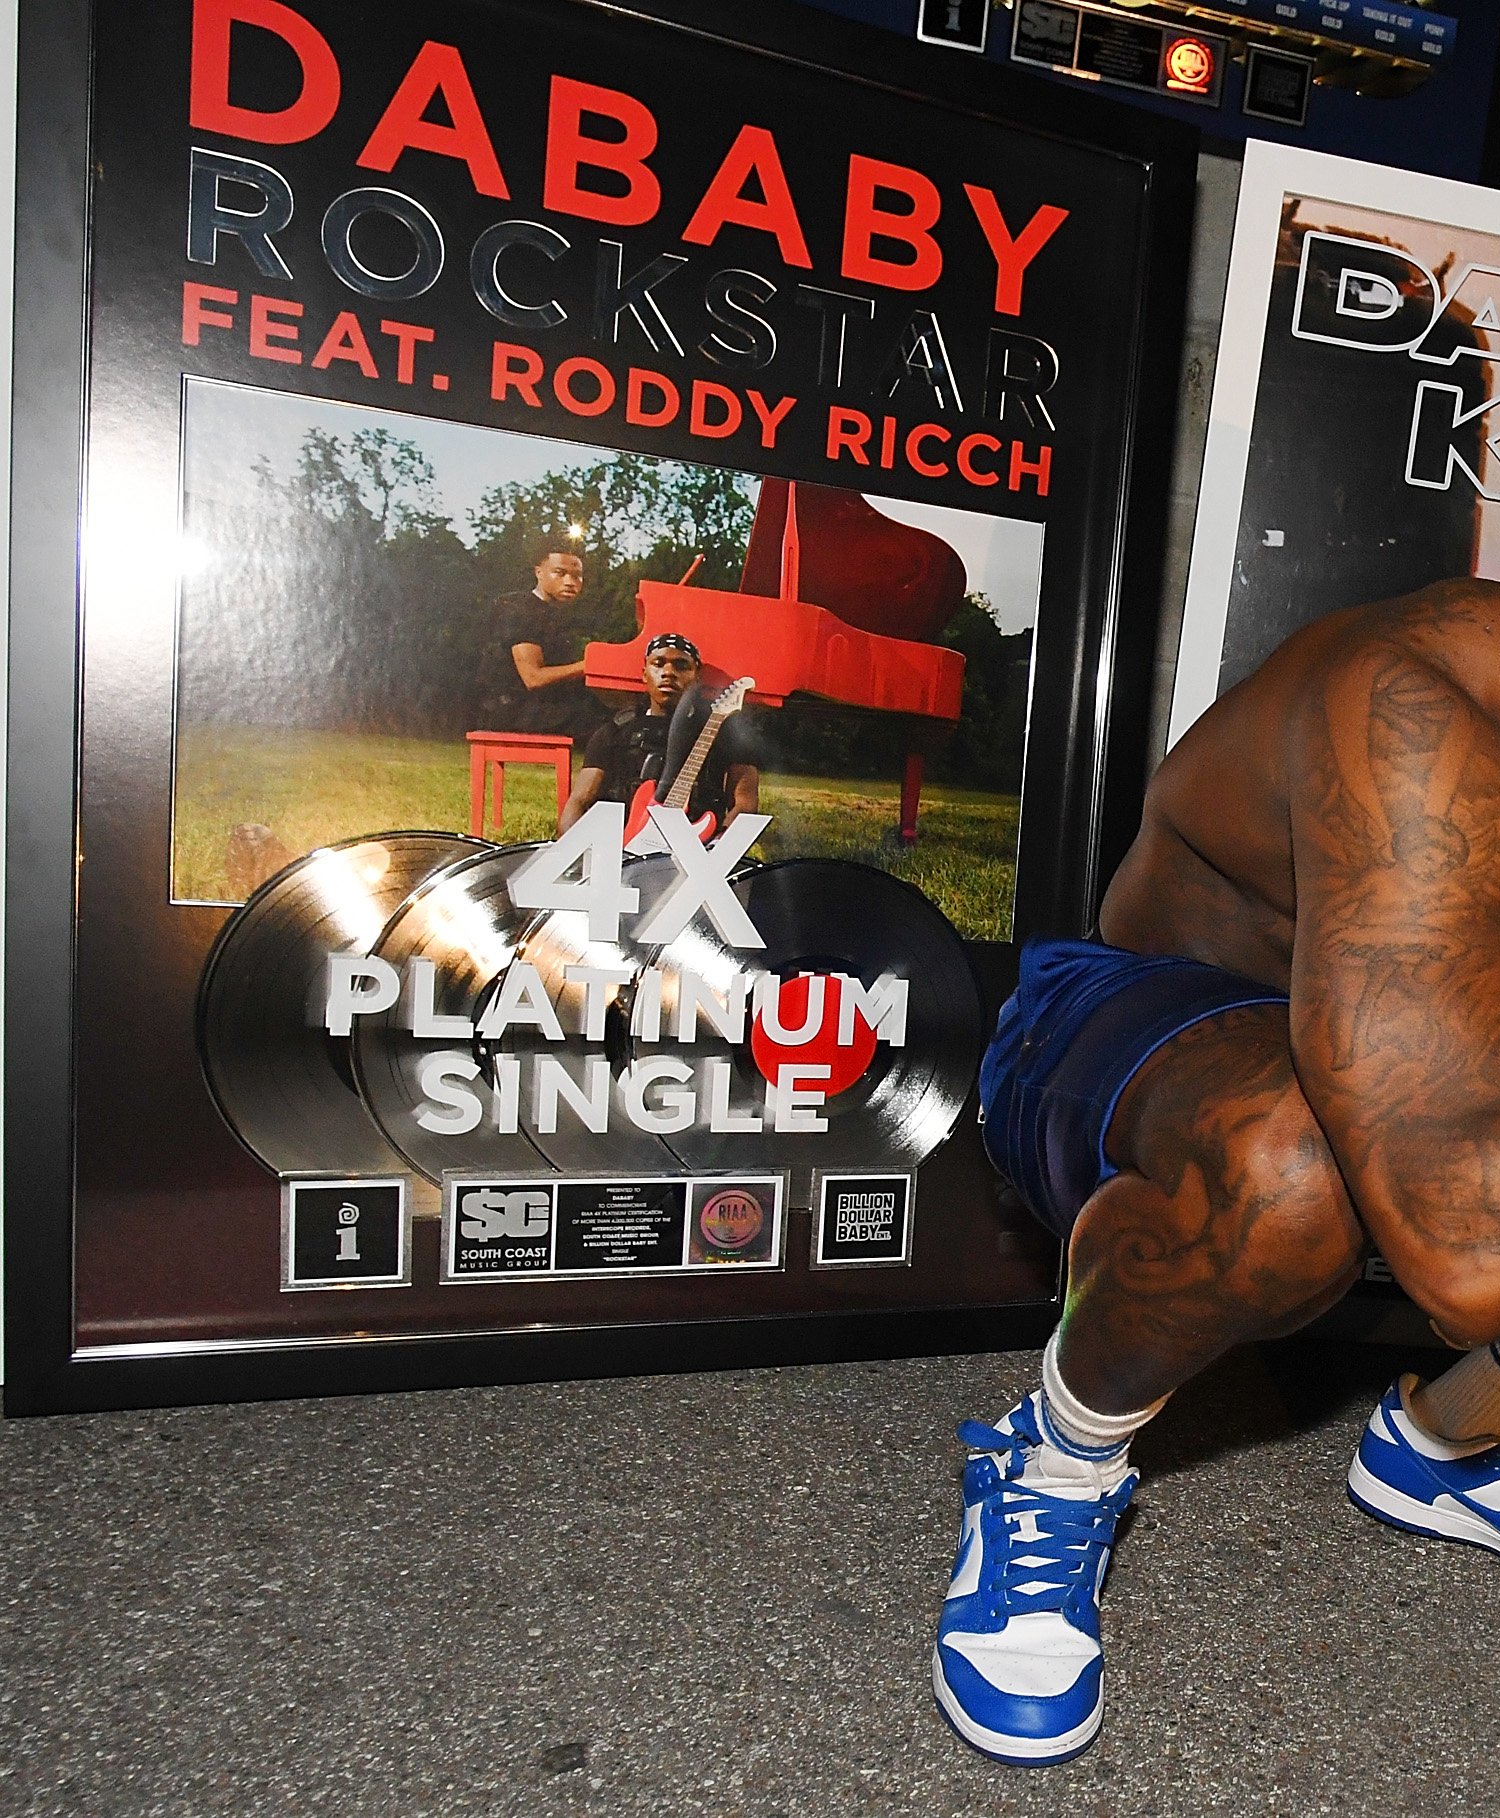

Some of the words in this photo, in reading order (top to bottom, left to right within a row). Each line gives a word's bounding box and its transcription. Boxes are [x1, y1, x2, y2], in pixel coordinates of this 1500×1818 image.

[190, 0, 1069, 316] DABABY
[187, 146, 1060, 432] ROCKSTAR
[182, 281, 449, 390] FEAT.
[491, 341, 797, 449] RODDY
[827, 406, 1052, 498] RICCH
[511, 801, 773, 949] 4X
[325, 955, 910, 1048] PLATINUM
[416, 1055, 831, 1135] SINGLE
[718, 1204, 748, 1221] RIAA
[837, 1208, 893, 1225] DOLLAR
[838, 1193, 895, 1210] BILLION
[461, 1249, 502, 1260] SOUTH
[504, 1247, 548, 1259] COAST
[835, 1223, 880, 1243] BABY
[876, 1231, 892, 1241] ENT.
[459, 1261, 499, 1269] MUSIC
[506, 1259, 548, 1267] GROUP
